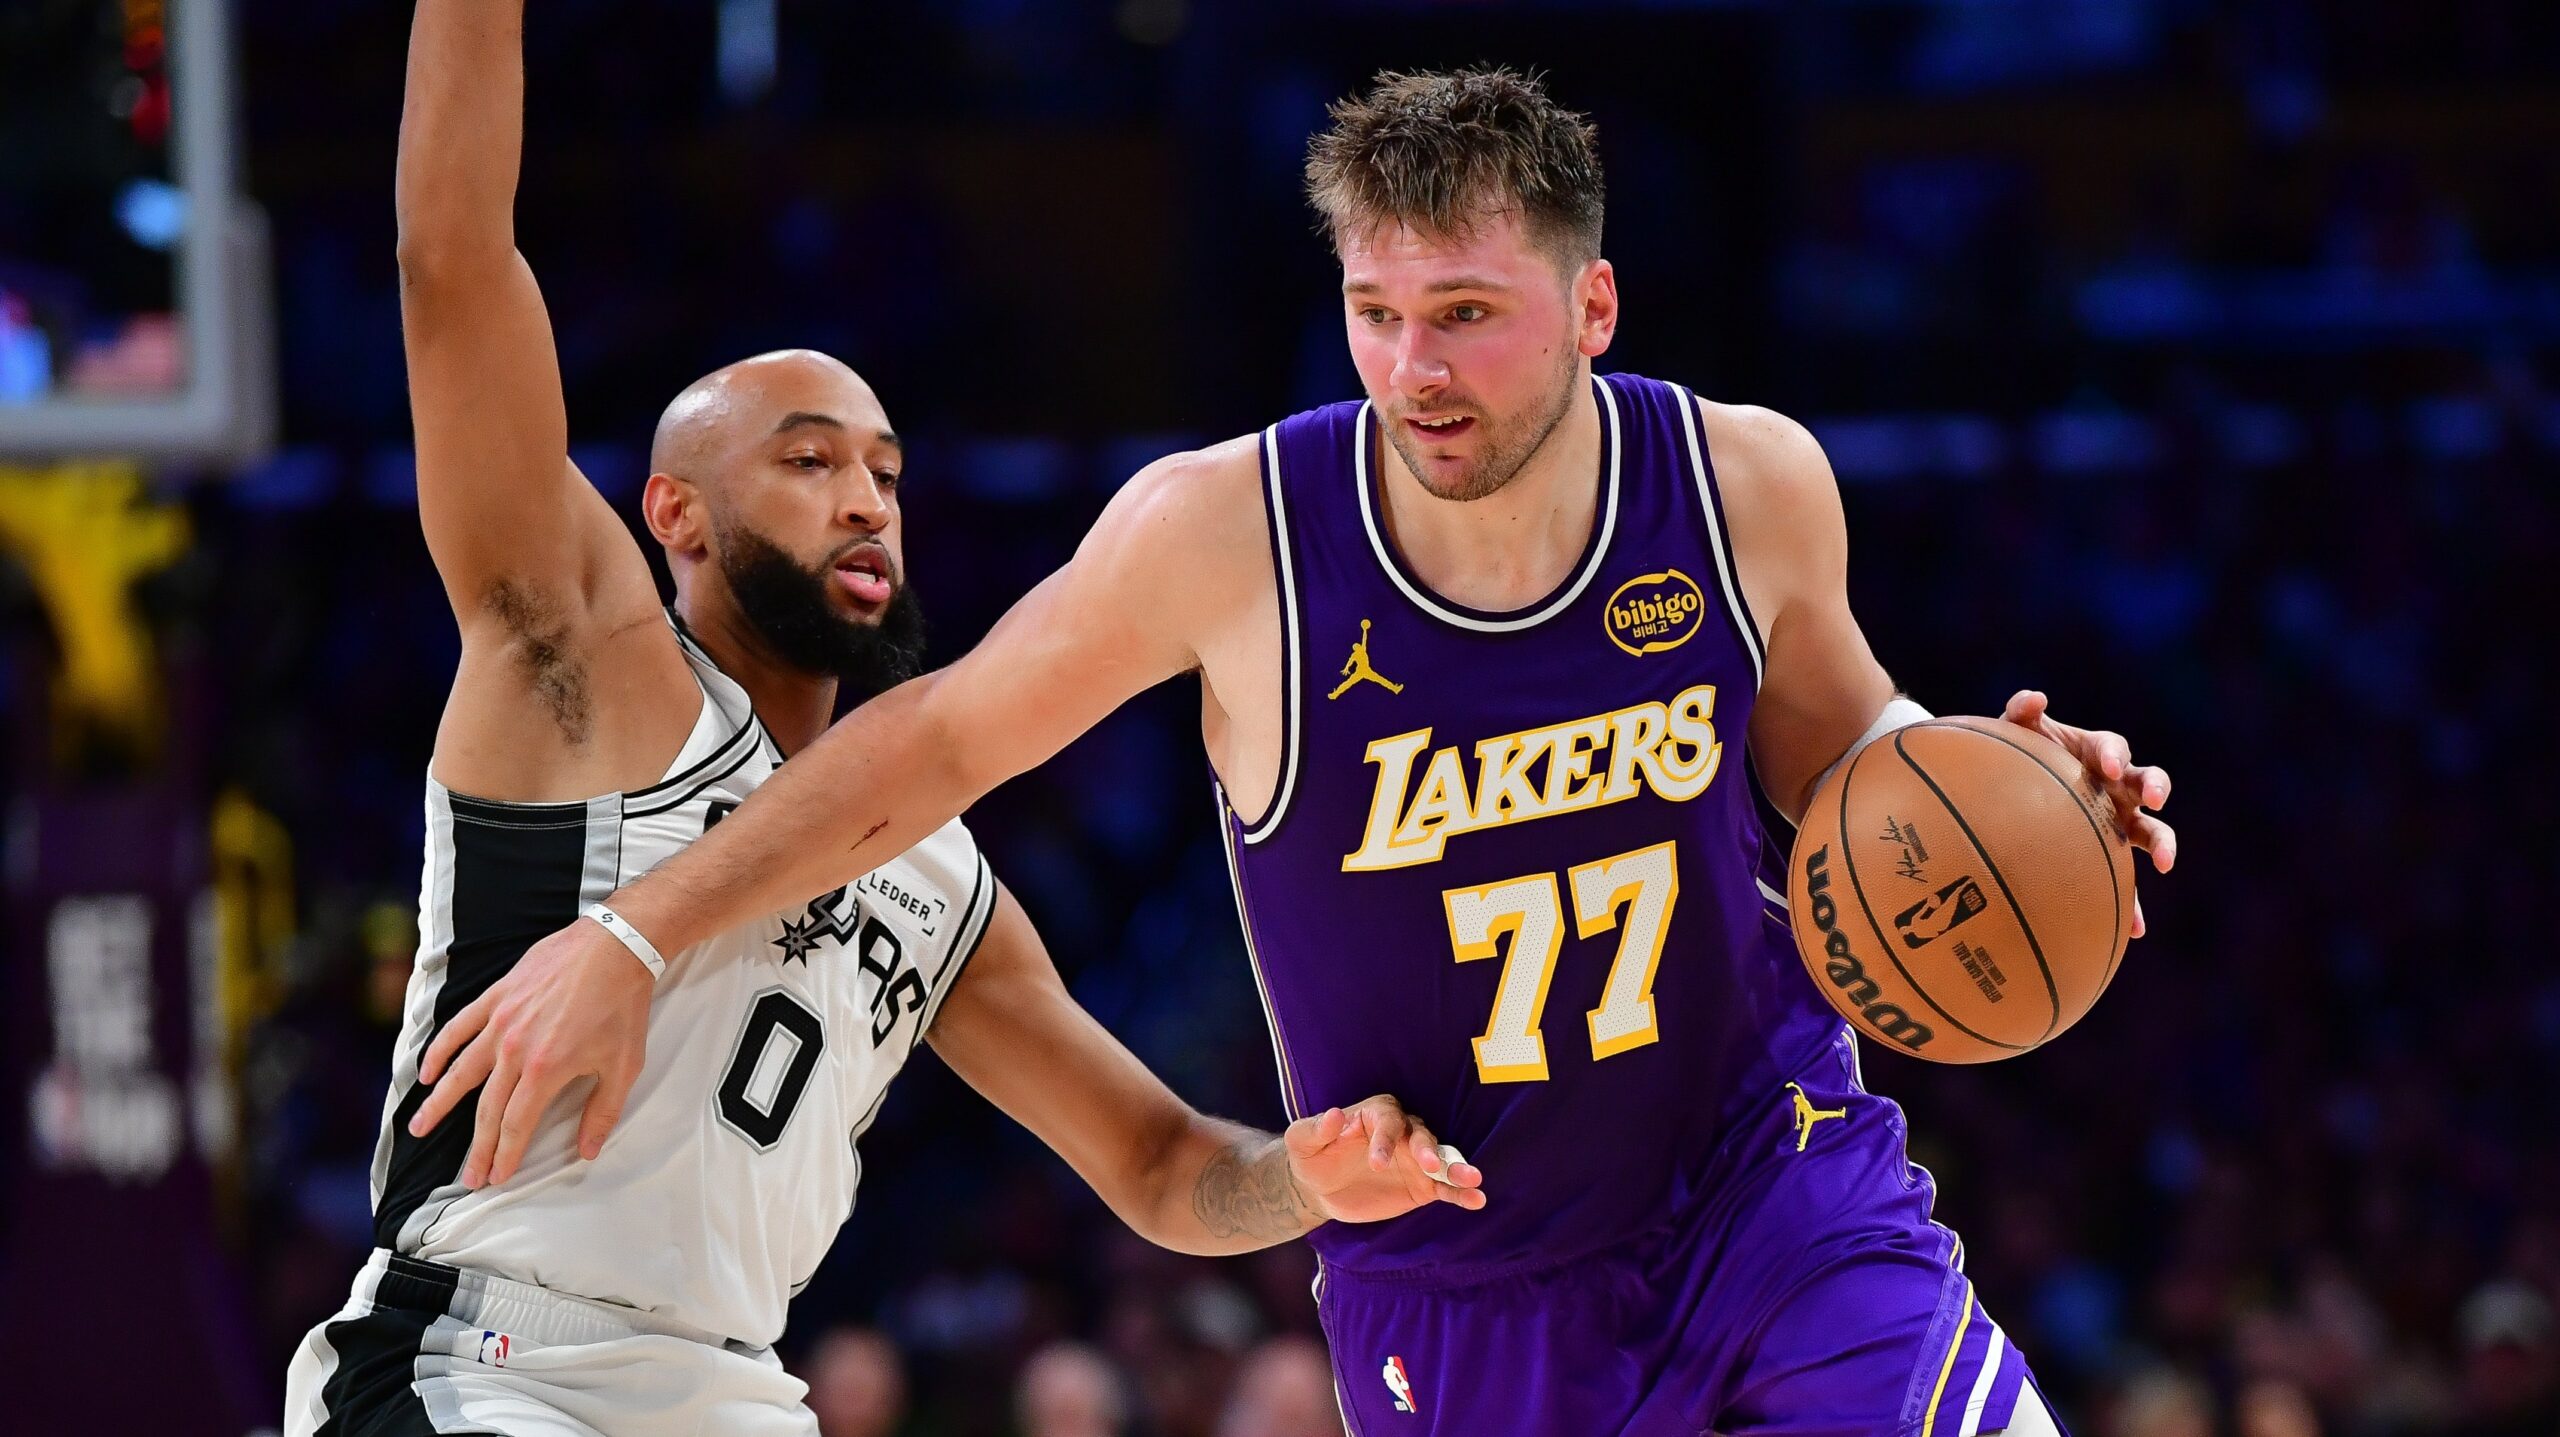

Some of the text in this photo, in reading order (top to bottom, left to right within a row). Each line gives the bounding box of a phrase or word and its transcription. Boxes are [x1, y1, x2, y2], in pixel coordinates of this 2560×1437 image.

[1612, 592, 1698, 629] bibigo
[1632, 620, 1669, 638] 비비고
[1341, 685, 1722, 871] LAKERS
[869, 872, 931, 921] LEDGER
[1443, 840, 1679, 1083] 77
[712, 984, 827, 1155] 0
